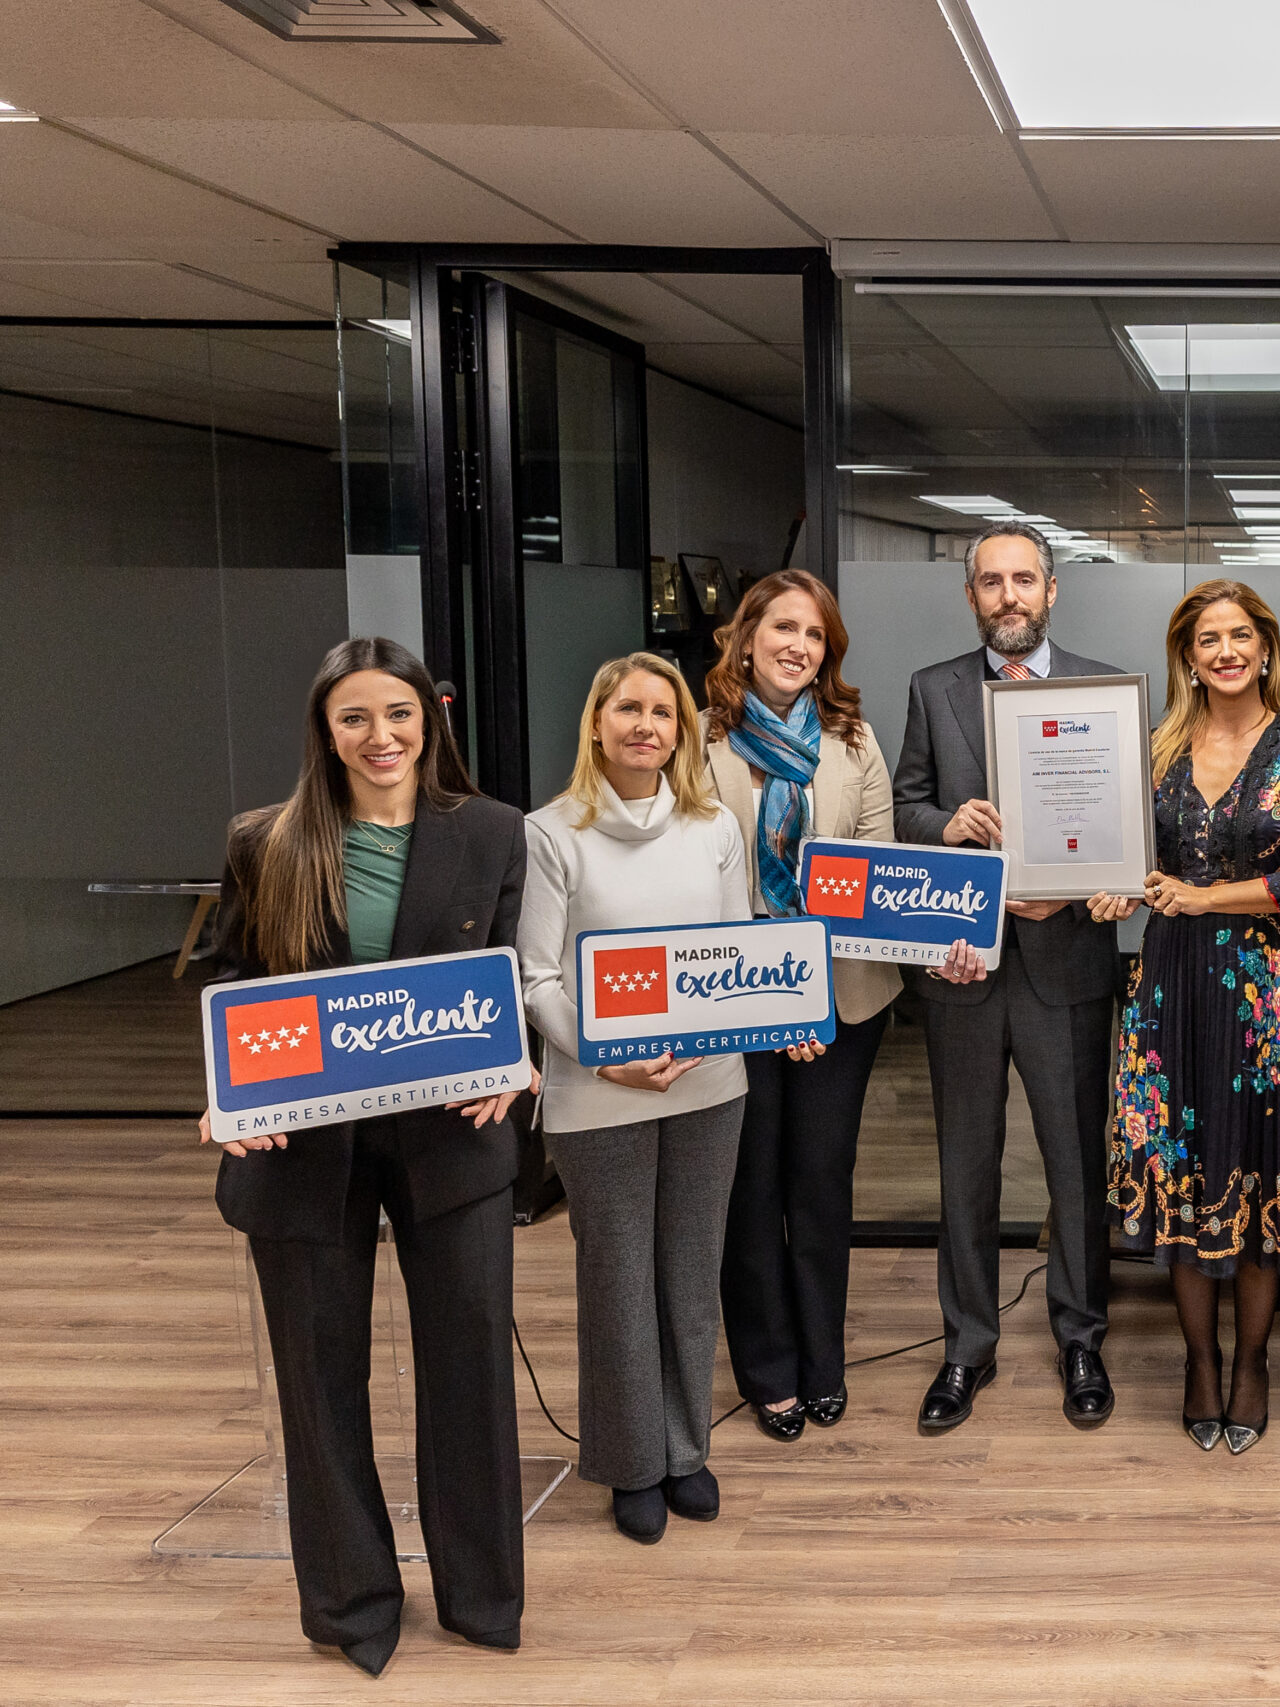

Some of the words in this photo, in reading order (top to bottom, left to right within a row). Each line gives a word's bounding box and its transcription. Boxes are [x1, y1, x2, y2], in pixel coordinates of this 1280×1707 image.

[873, 864, 929, 880] MADRID
[871, 877, 989, 915] excelente
[674, 946, 739, 963] MADRID
[835, 942, 872, 955] RESA
[881, 946, 950, 961] CERTIFIC
[675, 951, 814, 998] excelente
[327, 989, 409, 1013] MADRID
[330, 989, 502, 1053] excelente
[598, 1040, 684, 1058] EMPRESA
[696, 1028, 818, 1049] CERTIFICADA
[237, 1103, 346, 1131] EMPRESA
[361, 1074, 511, 1110] CERTIFICADA
